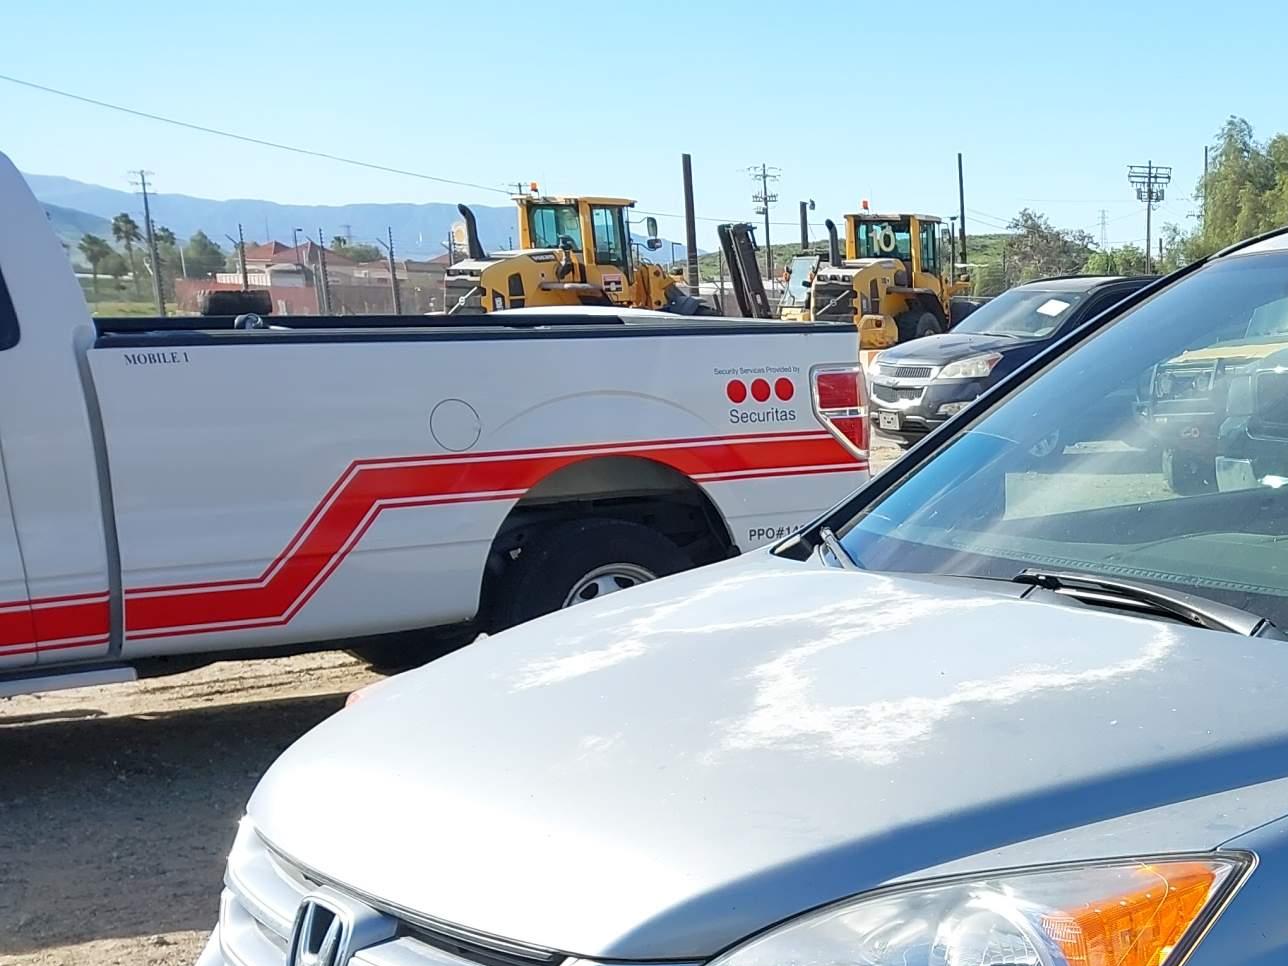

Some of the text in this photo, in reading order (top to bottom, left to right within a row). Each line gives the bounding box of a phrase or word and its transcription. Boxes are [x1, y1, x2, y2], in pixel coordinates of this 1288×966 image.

[869, 224, 896, 256] 10
[124, 352, 189, 365] MOBILE 1
[739, 367, 765, 375] Services
[766, 366, 792, 374] Provided
[729, 407, 796, 424] Securitas
